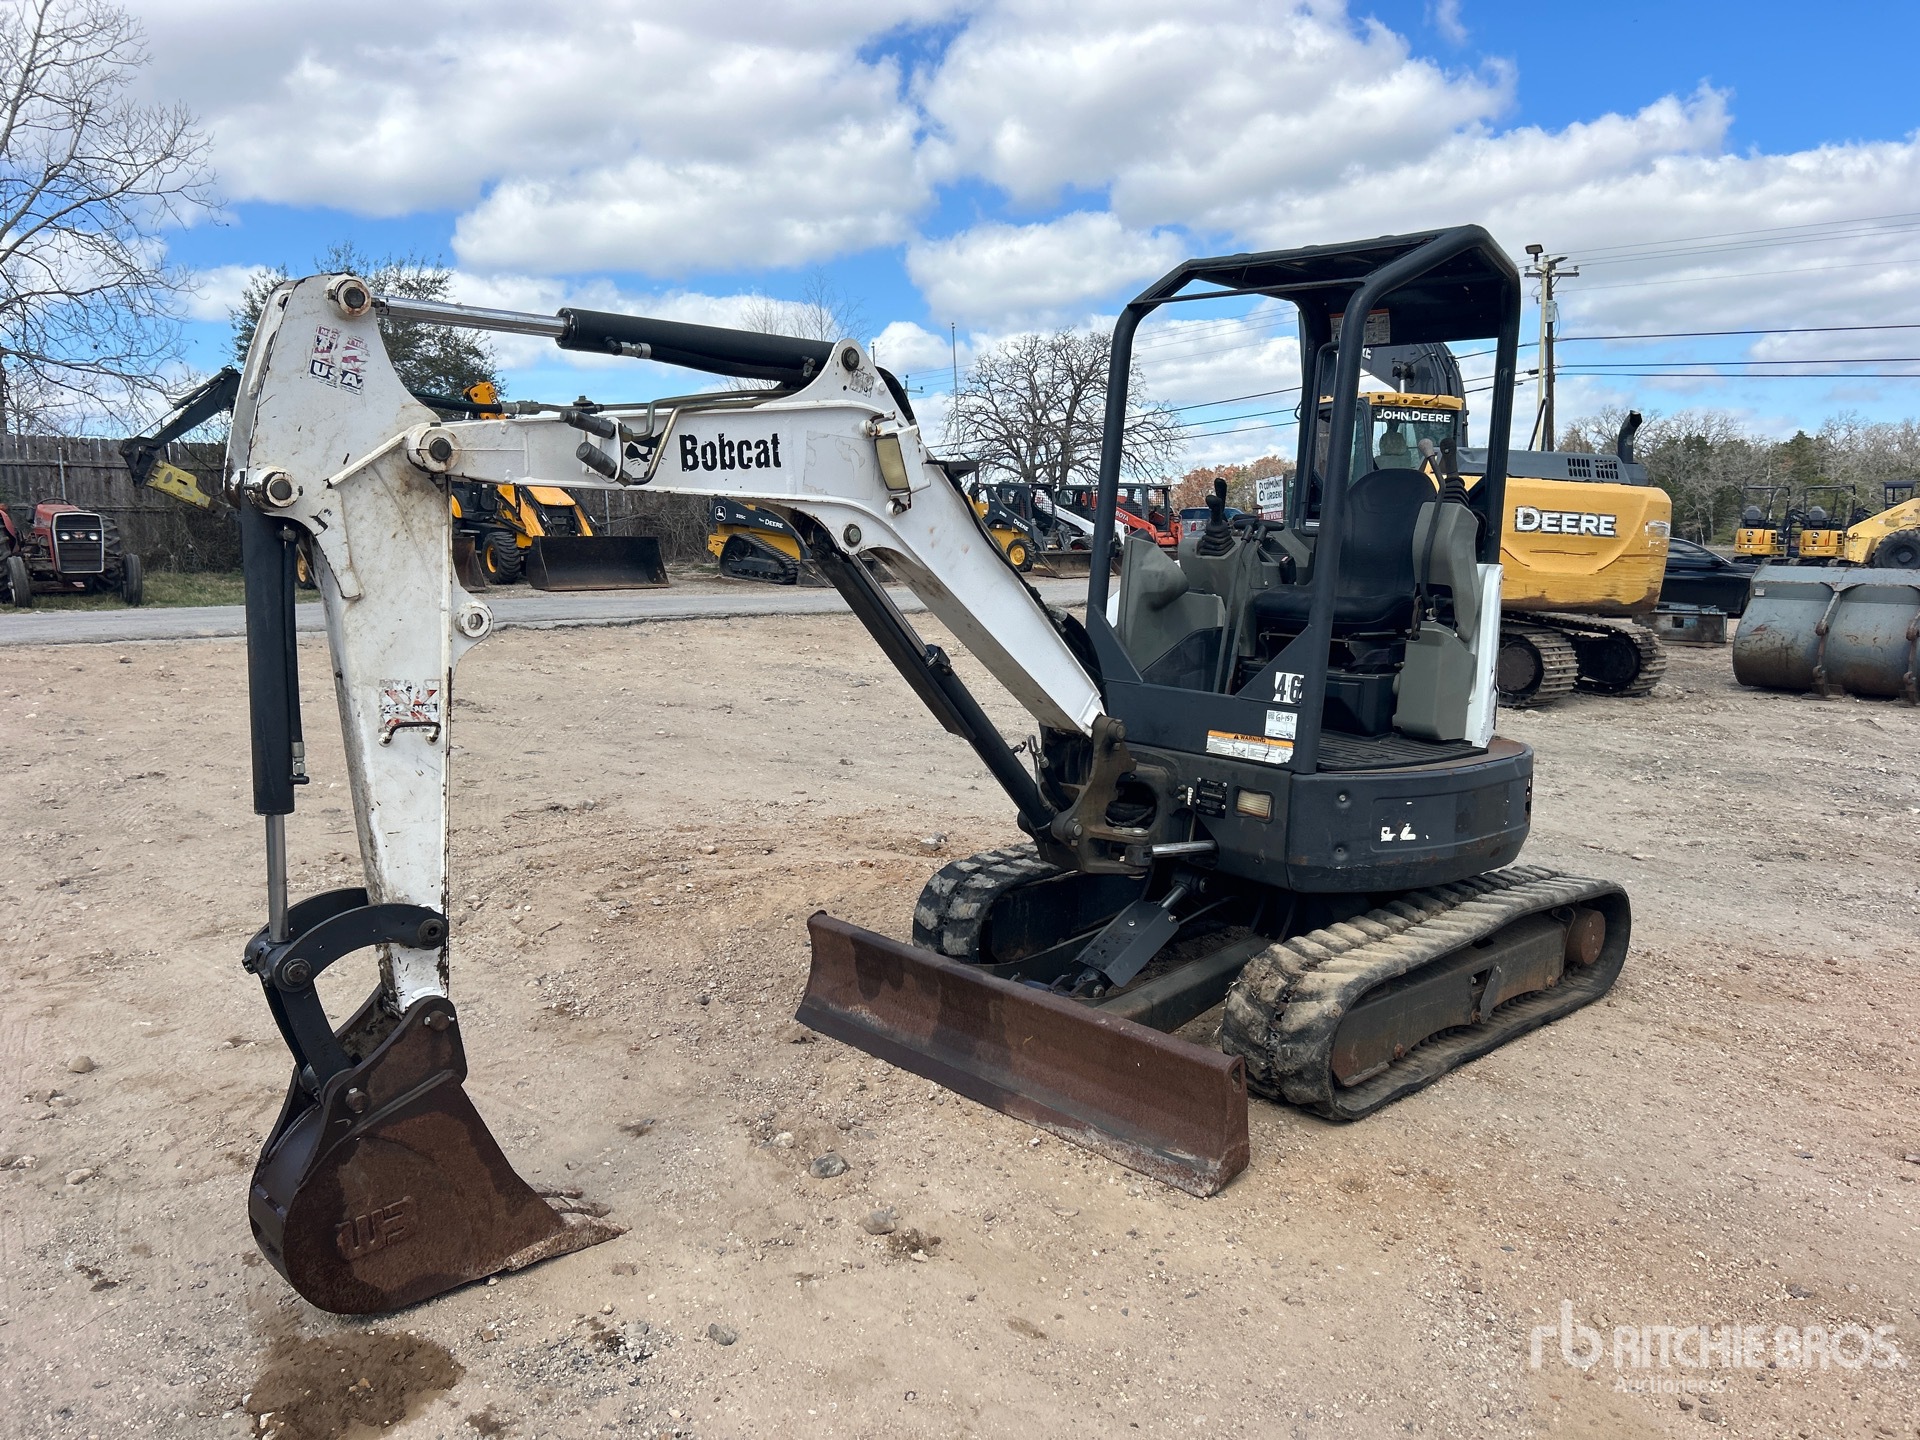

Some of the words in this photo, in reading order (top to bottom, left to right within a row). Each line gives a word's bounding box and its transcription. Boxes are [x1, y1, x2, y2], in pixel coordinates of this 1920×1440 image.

[1376, 408, 1410, 421] JOHN
[1411, 410, 1451, 423] DEERE
[678, 432, 782, 472] Bobcat
[1115, 510, 1129, 522] BOTA
[1515, 505, 1617, 538] DEERE
[765, 518, 783, 529] DEERE
[1240, 734, 1266, 744] WARNING
